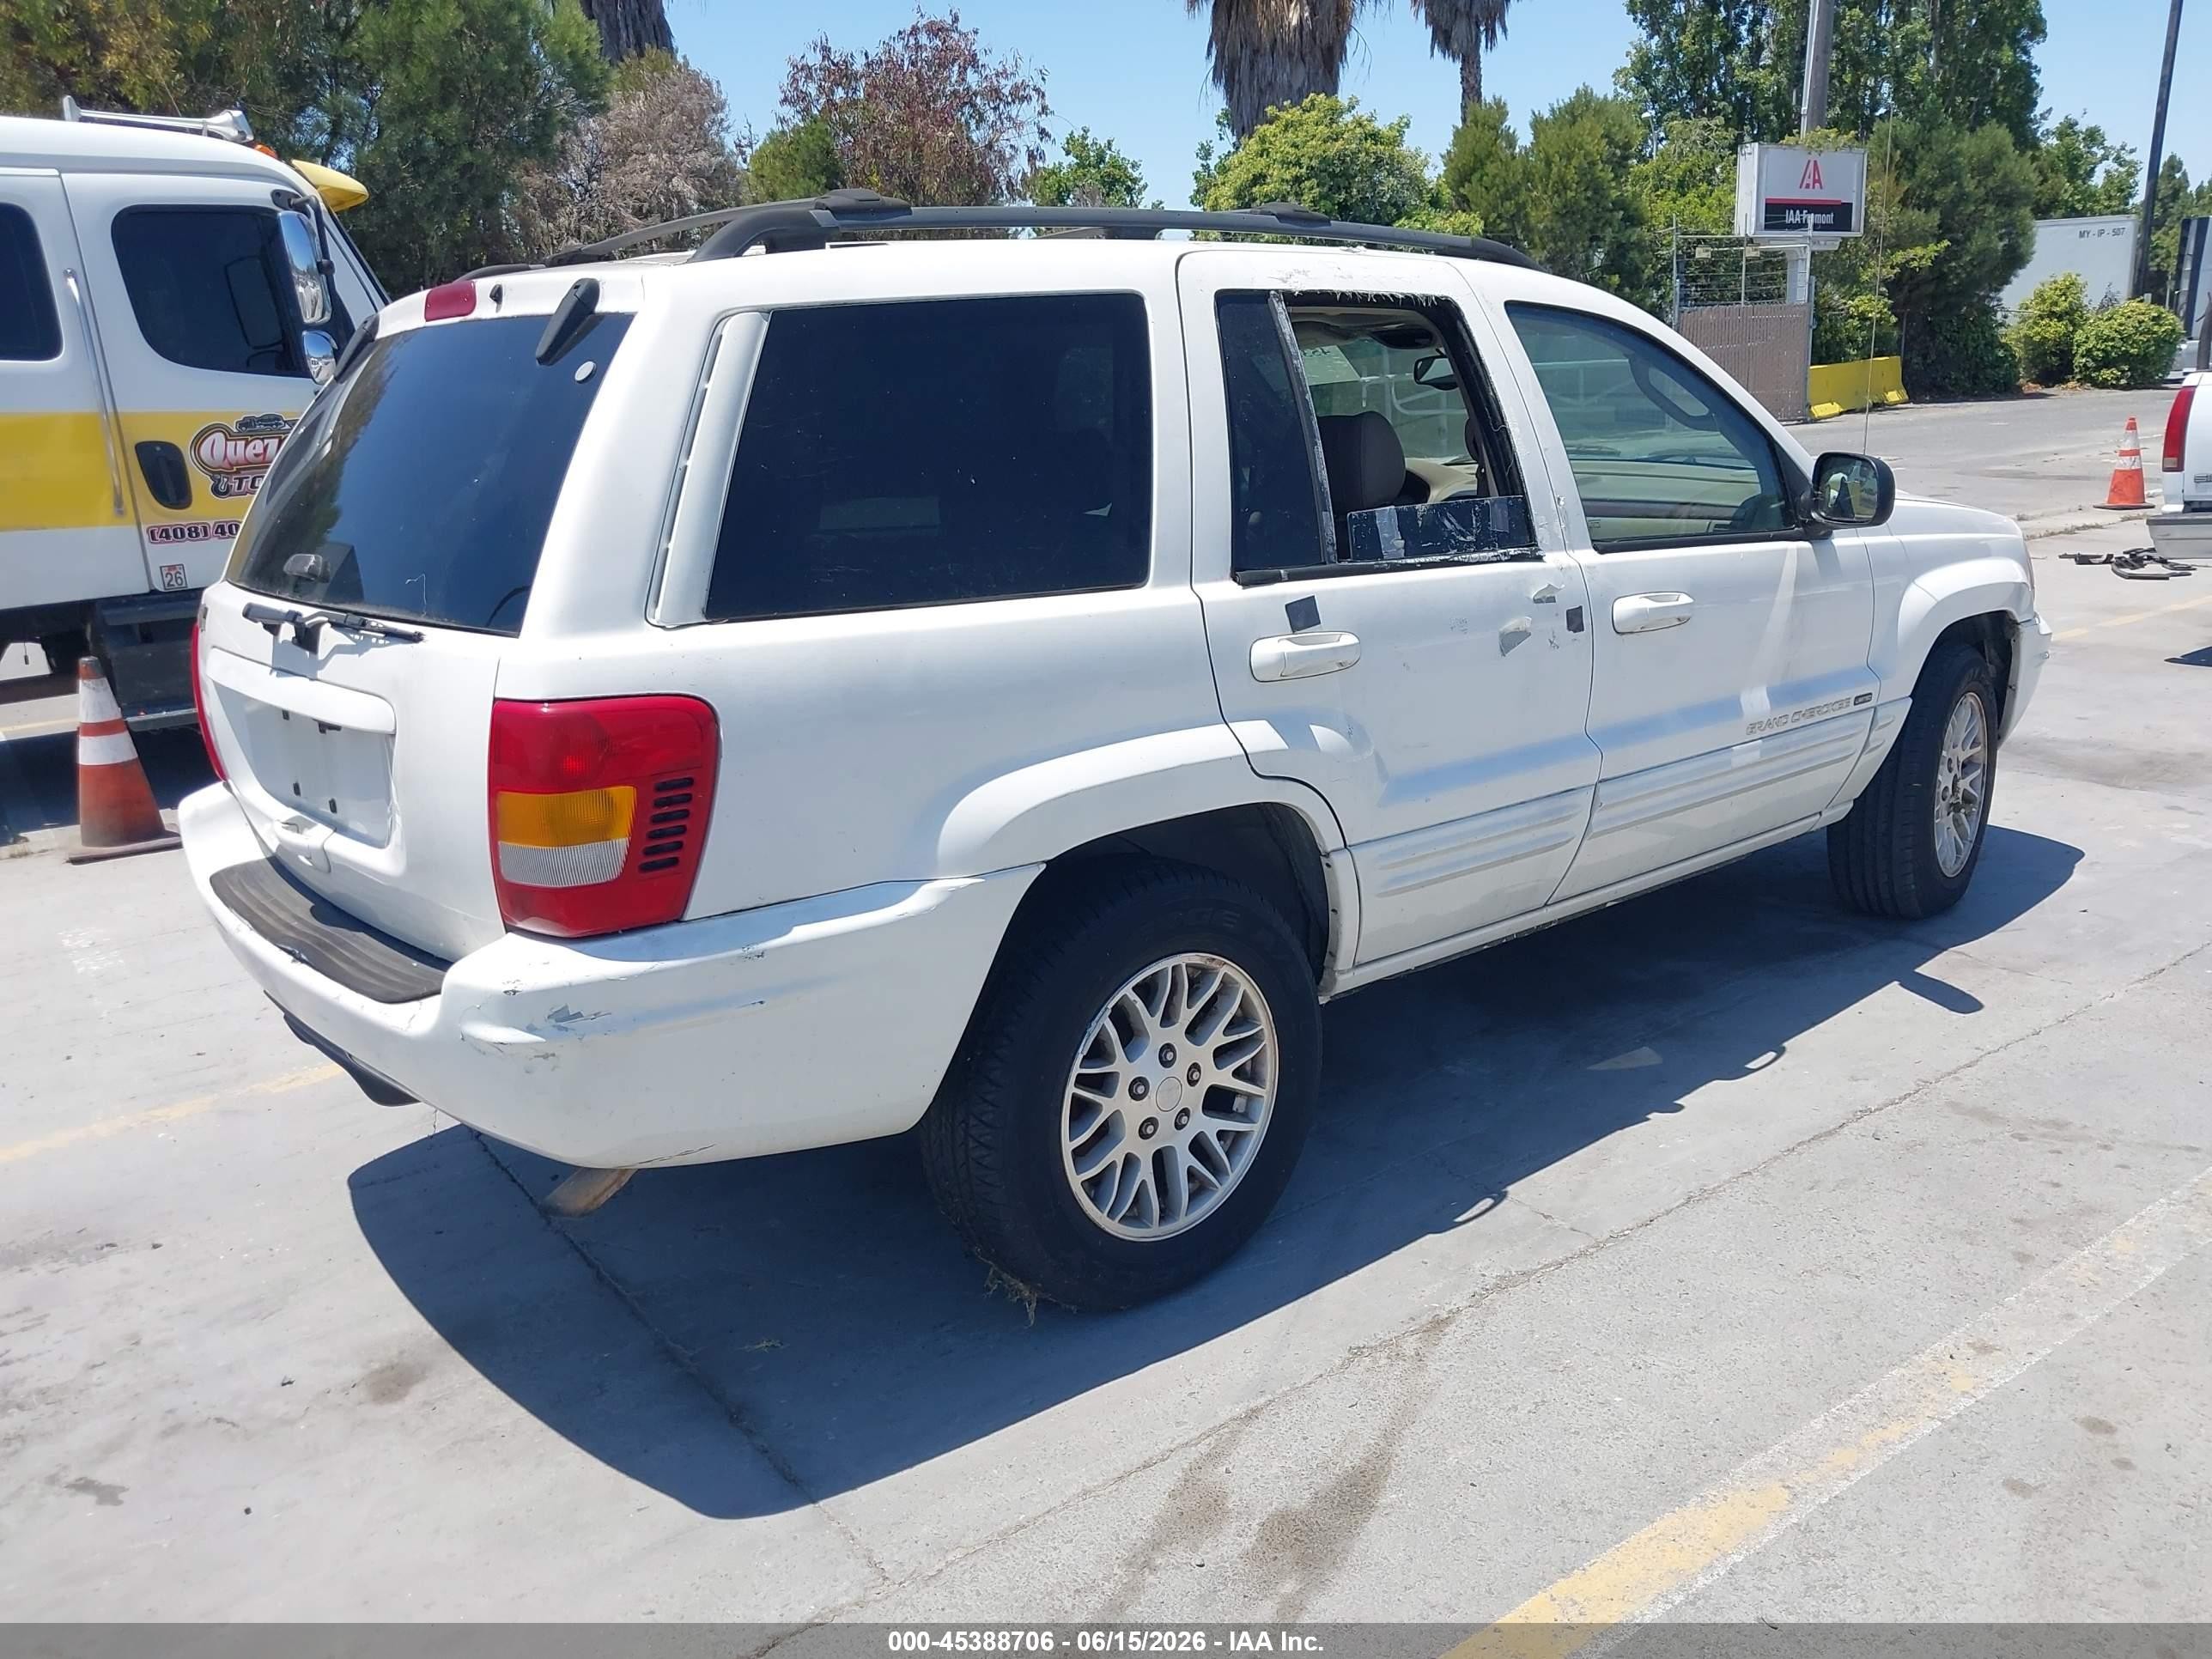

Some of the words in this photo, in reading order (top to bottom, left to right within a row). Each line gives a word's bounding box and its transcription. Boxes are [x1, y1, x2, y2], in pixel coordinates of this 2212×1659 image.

[1785, 209, 1801, 224] IAA
[1802, 210, 1834, 224] Frmont
[2078, 229, 2091, 239] MY
[149, 525, 209, 542] (408)
[165, 570, 184, 587] 26
[1746, 714, 1789, 735] GRAND
[1791, 697, 1851, 723] CHEROKEE
